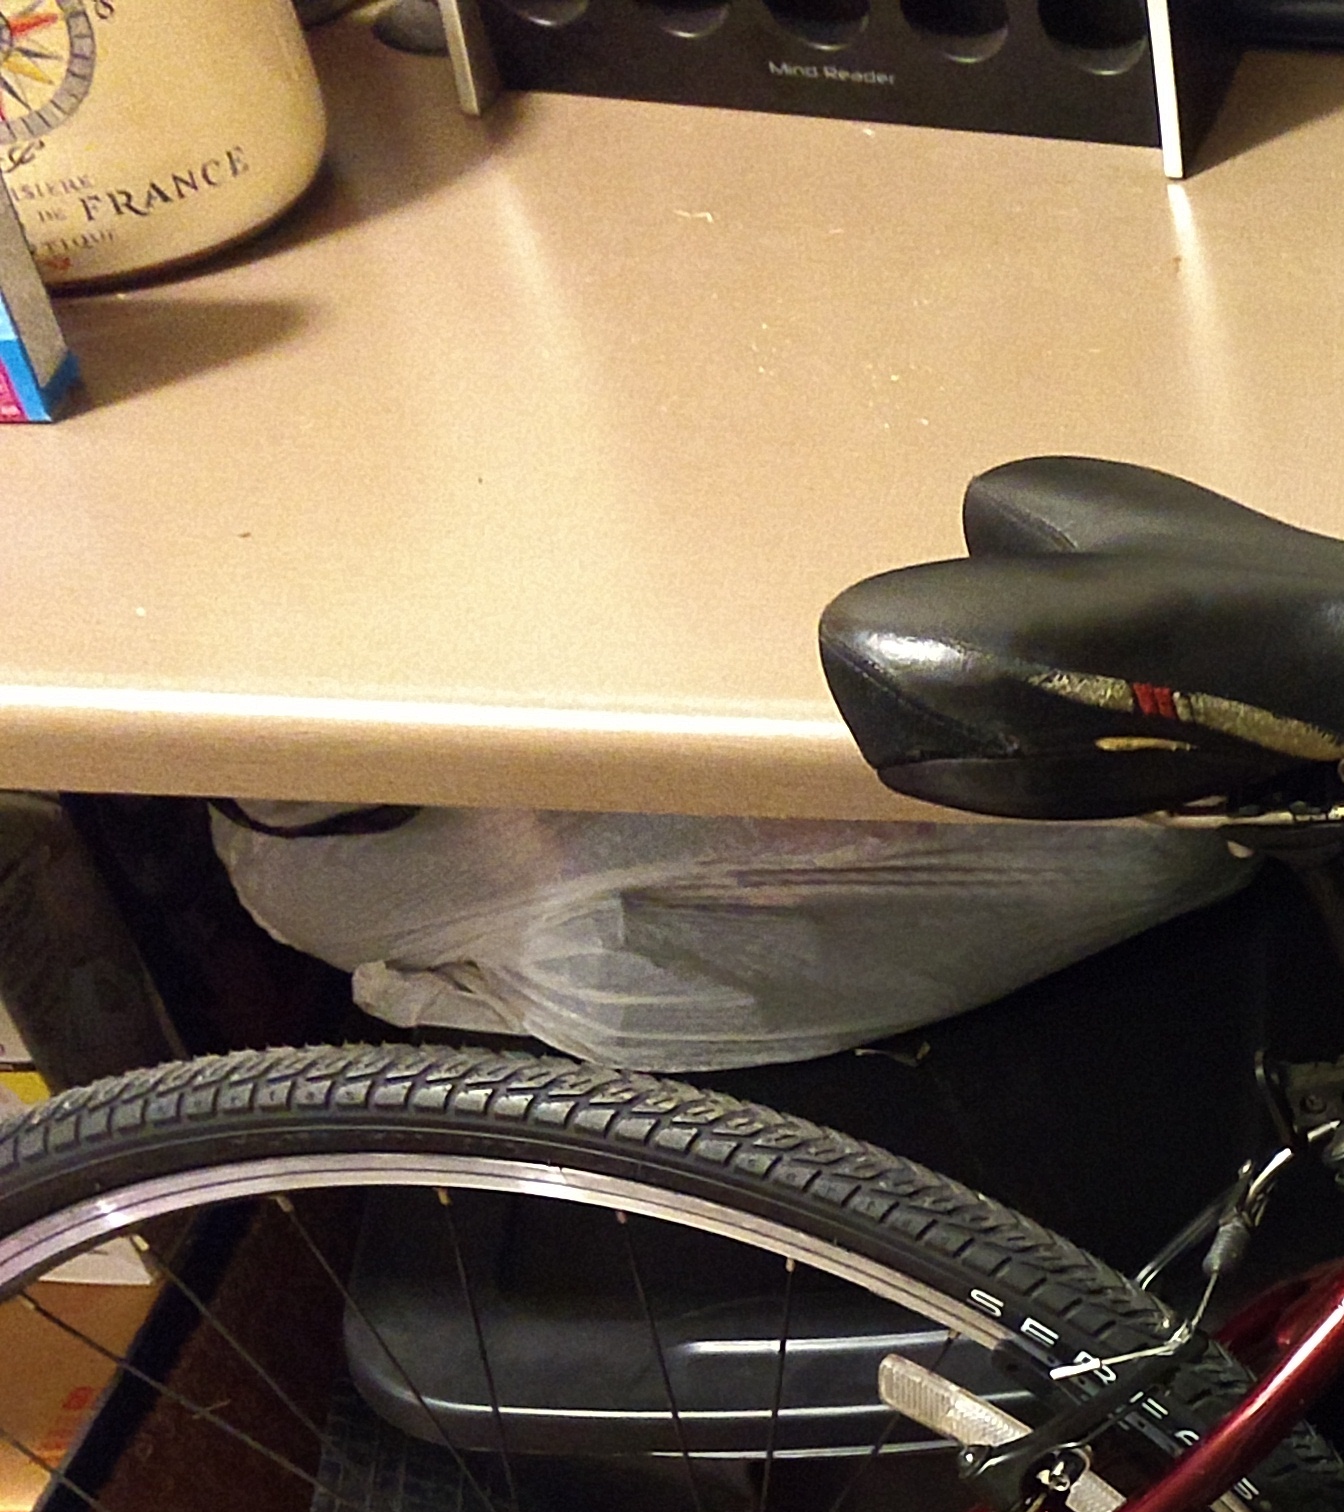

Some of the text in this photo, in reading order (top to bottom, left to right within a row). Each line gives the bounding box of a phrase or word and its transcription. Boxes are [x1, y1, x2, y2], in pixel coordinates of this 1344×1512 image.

[768, 60, 895, 85] Mind Reader
[80, 146, 250, 222] FRANCE
